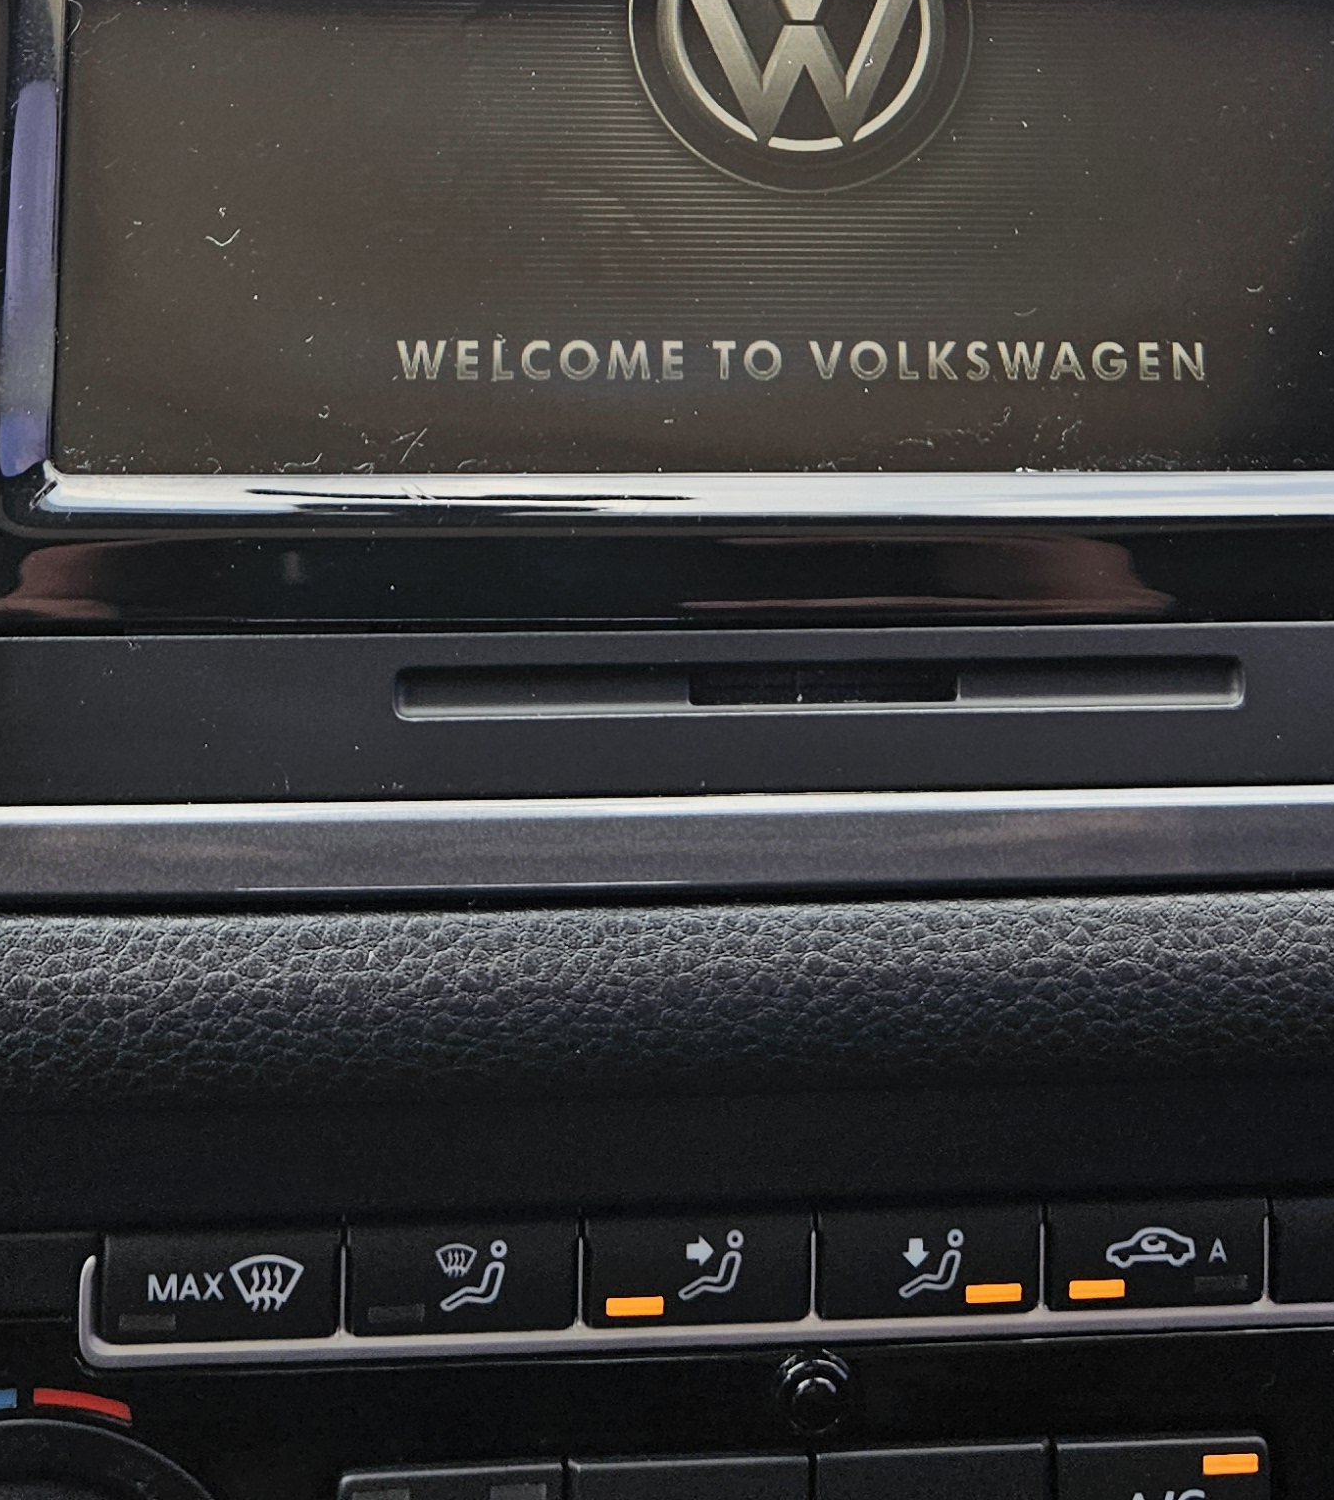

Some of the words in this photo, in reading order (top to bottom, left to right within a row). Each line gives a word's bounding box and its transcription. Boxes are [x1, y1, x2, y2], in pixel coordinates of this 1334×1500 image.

[396, 339, 684, 381] WELCOME
[712, 340, 782, 381] TO
[808, 340, 1206, 381] VOLKSWAGEN
[1209, 1238, 1227, 1263] A
[146, 1273, 224, 1303] MAX
